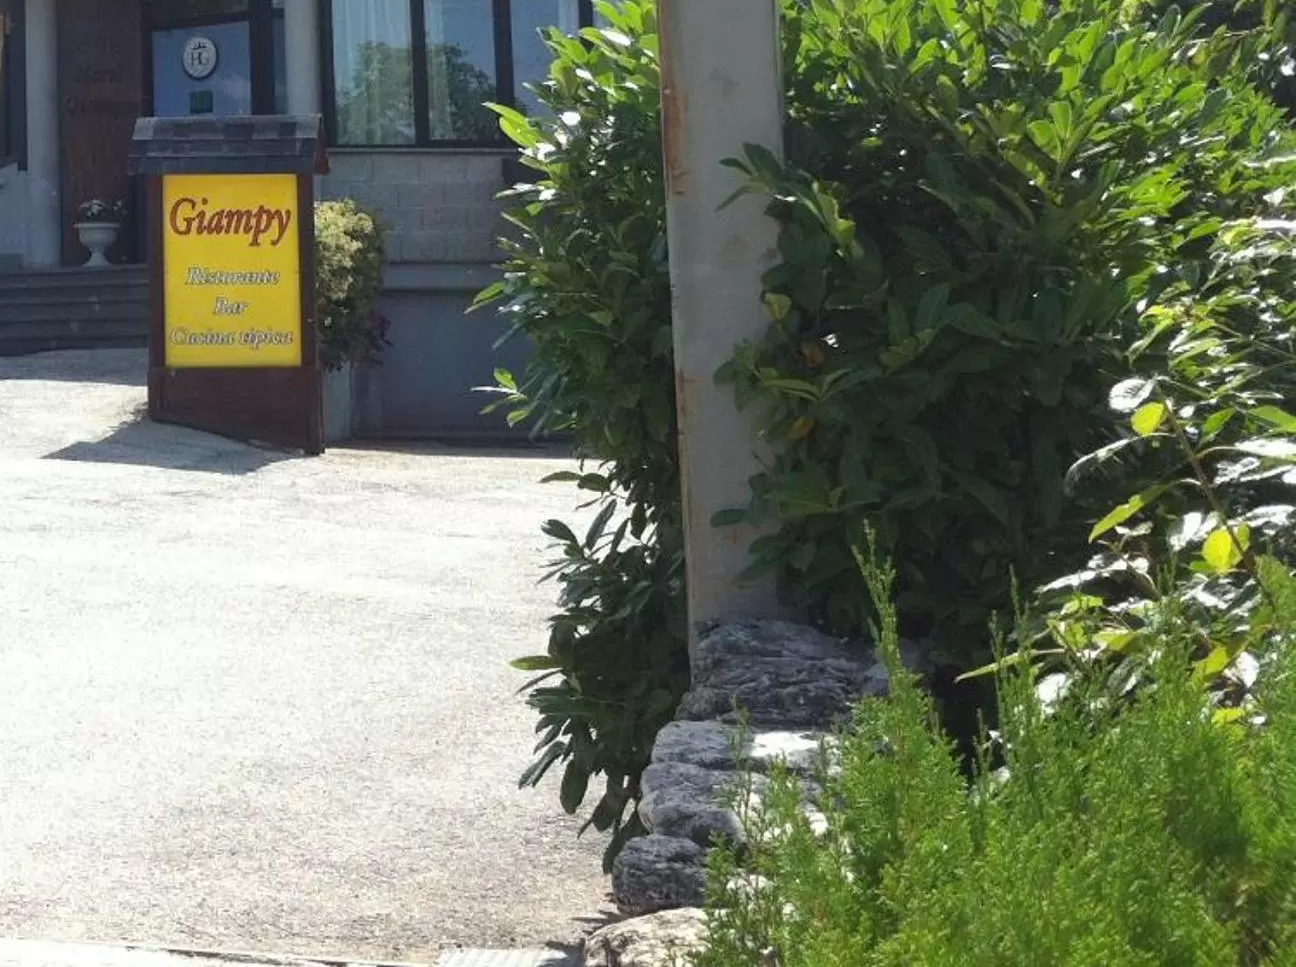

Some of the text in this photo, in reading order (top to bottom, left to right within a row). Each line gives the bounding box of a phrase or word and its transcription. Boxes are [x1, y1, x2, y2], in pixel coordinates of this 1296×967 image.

[169, 197, 292, 246] Giampy
[184, 266, 281, 286] Ristorante
[212, 296, 249, 316] Bar
[169, 326, 294, 349] Cucina tipica
